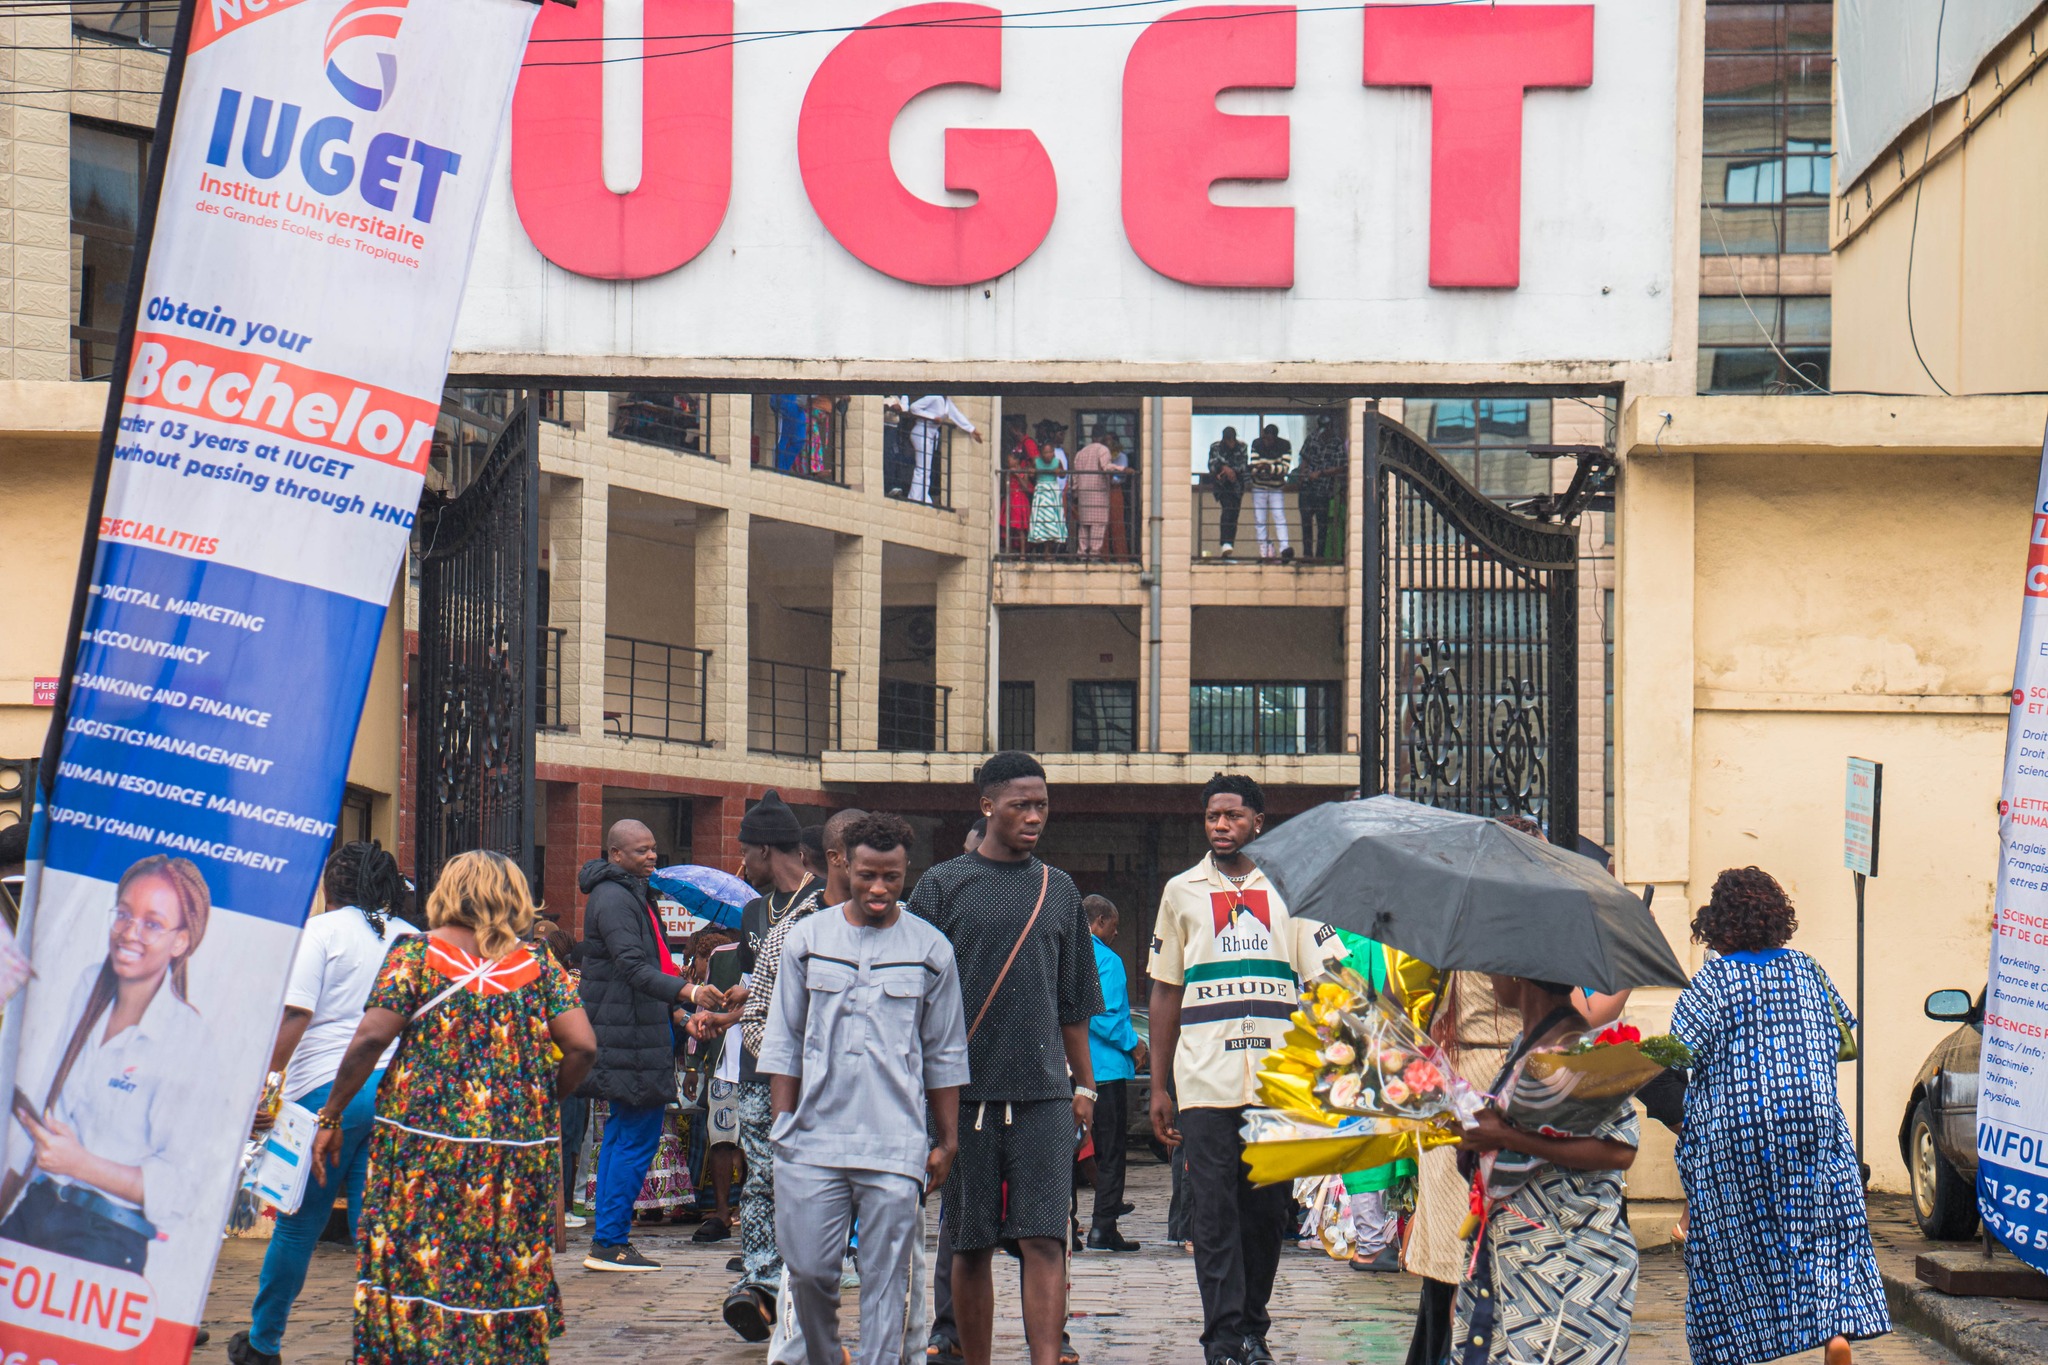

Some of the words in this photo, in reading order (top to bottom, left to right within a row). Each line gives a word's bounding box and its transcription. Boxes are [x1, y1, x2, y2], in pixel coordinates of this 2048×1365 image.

[206, 87, 462, 224] IUGET
[199, 172, 281, 209] Institut
[286, 192, 425, 250] Universitaire
[196, 200, 220, 215] des
[223, 206, 278, 229] Grandes
[281, 219, 323, 242] Ecoles
[327, 233, 351, 248] des
[355, 239, 420, 269] Tropiques
[147, 296, 237, 337] Obtain
[239, 321, 314, 354] your
[125, 341, 435, 465] Bachelor
[160, 420, 188, 440] 03
[190, 430, 250, 453] years
[254, 444, 281, 462] at
[284, 450, 355, 480] IUGET
[183, 458, 270, 493] passing
[275, 478, 366, 514] through
[369, 501, 417, 530] HND
[102, 583, 161, 611] DIGITAL
[165, 596, 266, 633] MARKETING
[152, 688, 188, 708] AND
[187, 695, 273, 728] FINANCE
[2028, 702, 2044, 714] ET
[67, 715, 147, 747] LOGISTICS
[144, 732, 274, 776] MANAGEMENT
[2022, 729, 2048, 742] Droit
[2020, 747, 2045, 759] Droit
[117, 772, 207, 808] RESOURCE
[206, 793, 337, 840] MANAGEMENT
[104, 816, 156, 843] CHAIN
[154, 829, 289, 875] MANAGEMENT
[2009, 840, 2047, 856] Anglais
[2007, 857, 2048, 874] Français
[2008, 876, 2039, 891] ettres
[664, 920, 696, 932] ENT
[1999, 924, 2016, 938] ET
[2017, 928, 2031, 942] DE
[1222, 933, 1268, 953] Rhude
[1999, 953, 2041, 975] arketing
[1196, 981, 1288, 1000] RHUDE
[2030, 981, 2040, 992] et
[1993, 988, 2036, 1009] Eonomie
[1231, 1038, 1266, 1049] RHUDE
[2021, 1045, 2042, 1058] Info
[2001, 1184, 2031, 1209] 26
